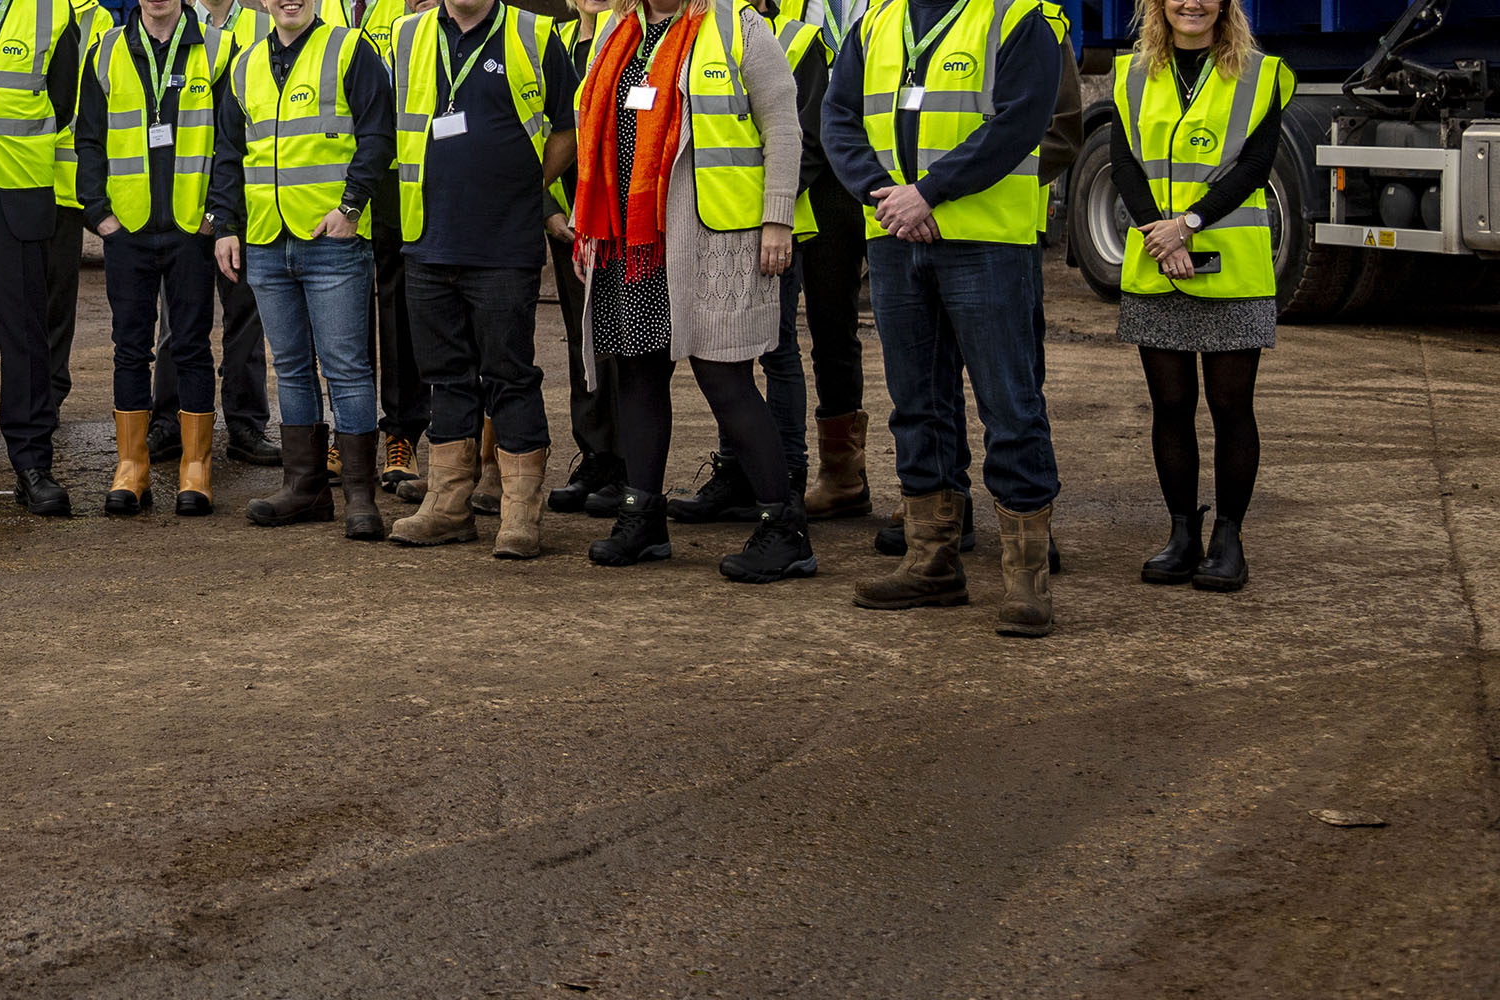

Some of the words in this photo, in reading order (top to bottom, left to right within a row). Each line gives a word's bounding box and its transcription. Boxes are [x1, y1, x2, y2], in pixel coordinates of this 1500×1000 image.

[371, 33, 389, 42] emr
[2, 46, 24, 55] emr
[943, 61, 970, 72] emr
[704, 69, 727, 79] emr
[190, 84, 206, 93] emr
[290, 92, 309, 103] emr
